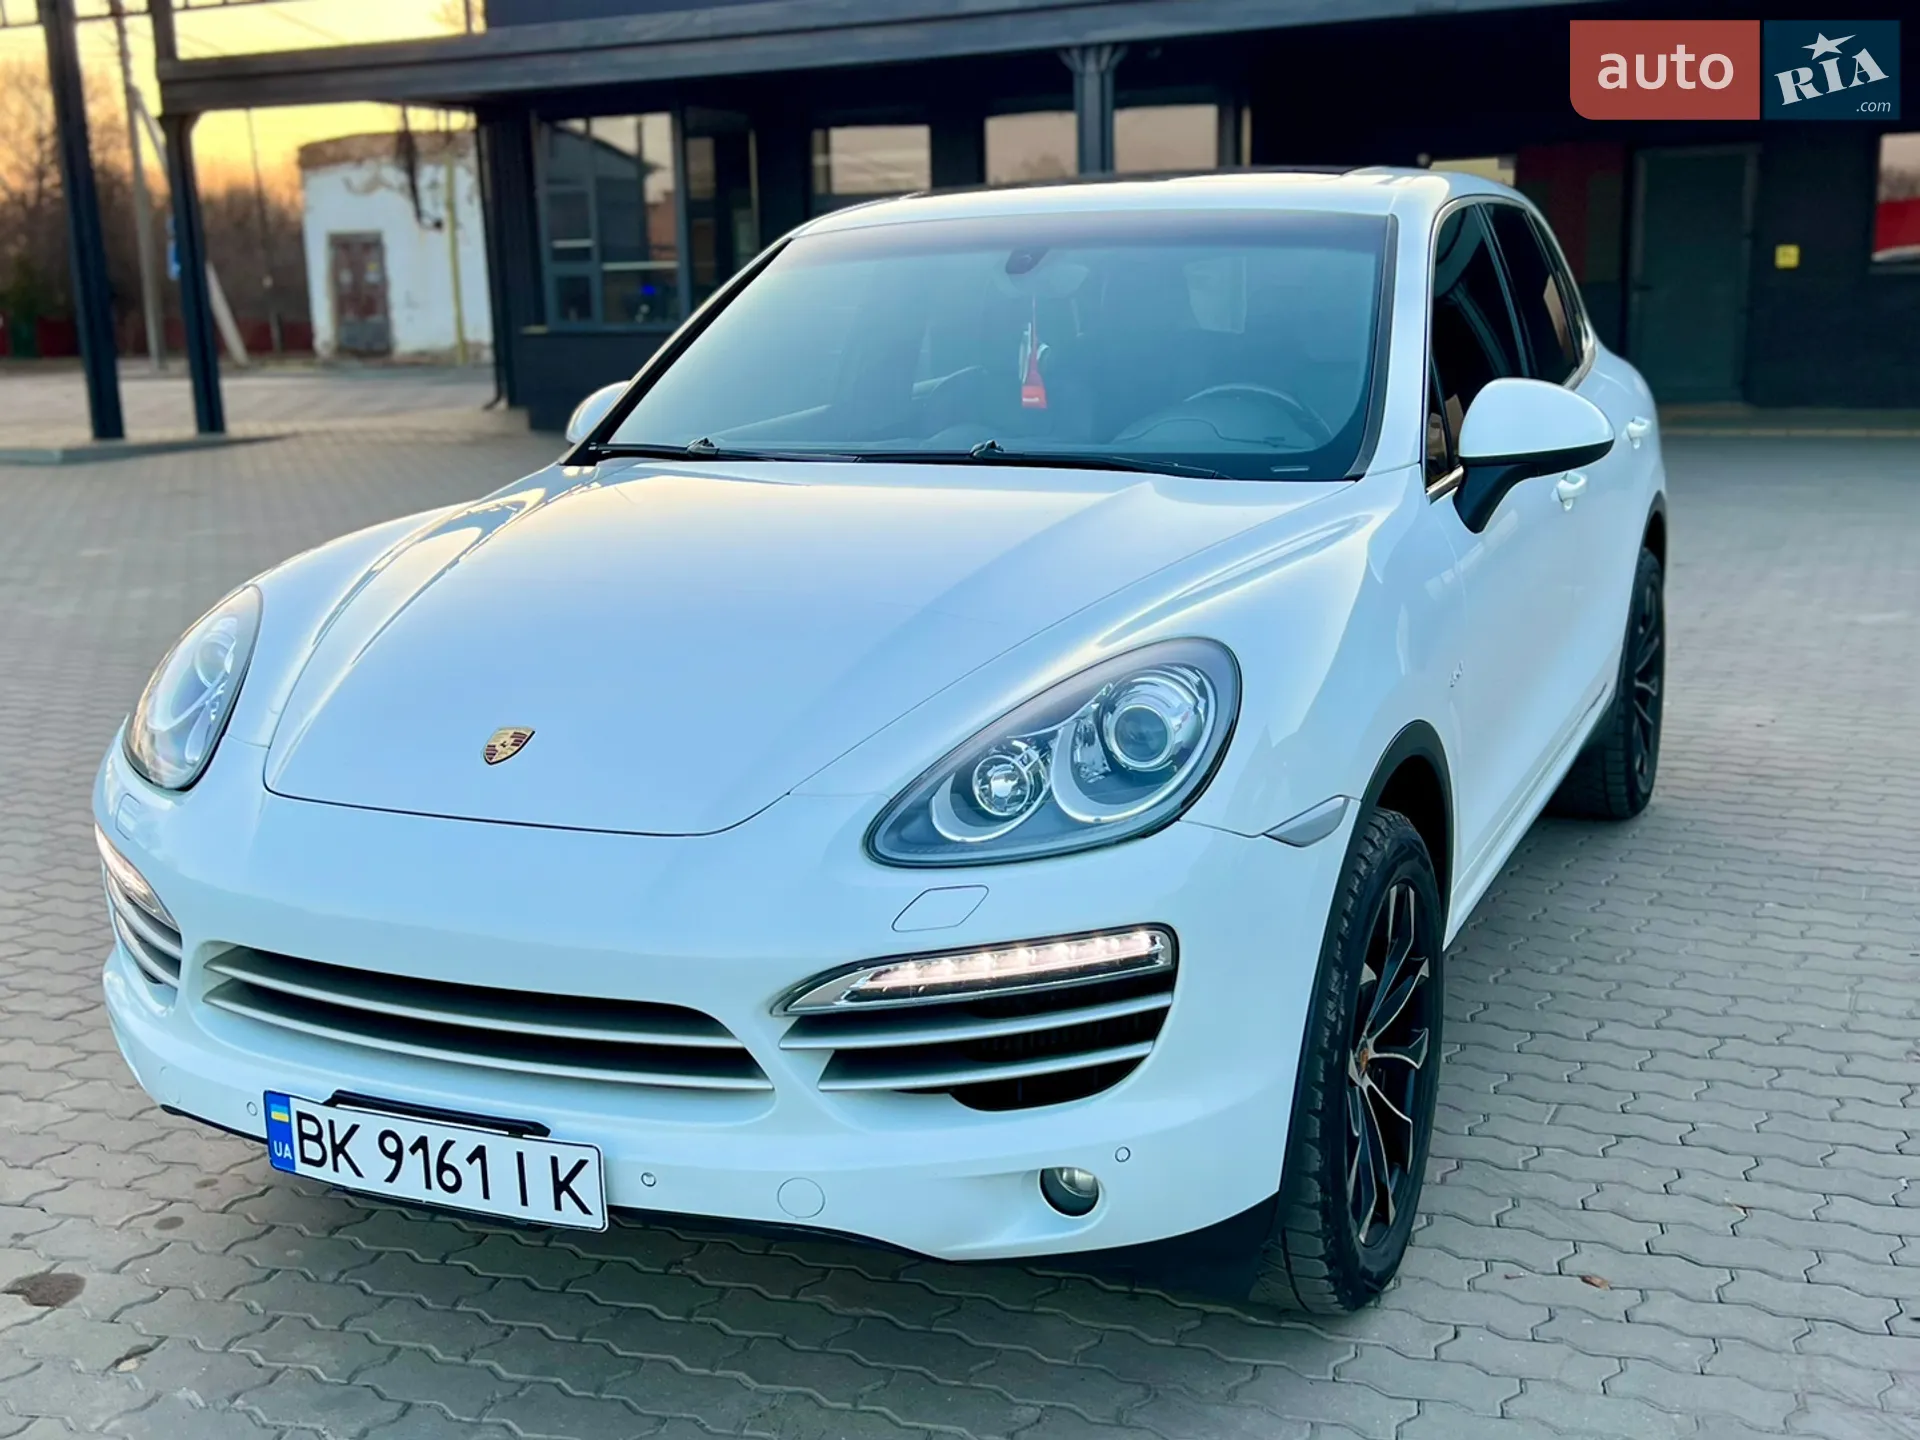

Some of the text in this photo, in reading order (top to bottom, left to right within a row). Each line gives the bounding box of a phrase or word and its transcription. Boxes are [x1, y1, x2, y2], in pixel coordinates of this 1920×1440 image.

[273, 1140, 293, 1160] UA
[296, 1110, 365, 1179] BK
[378, 1129, 491, 1200] 9161
